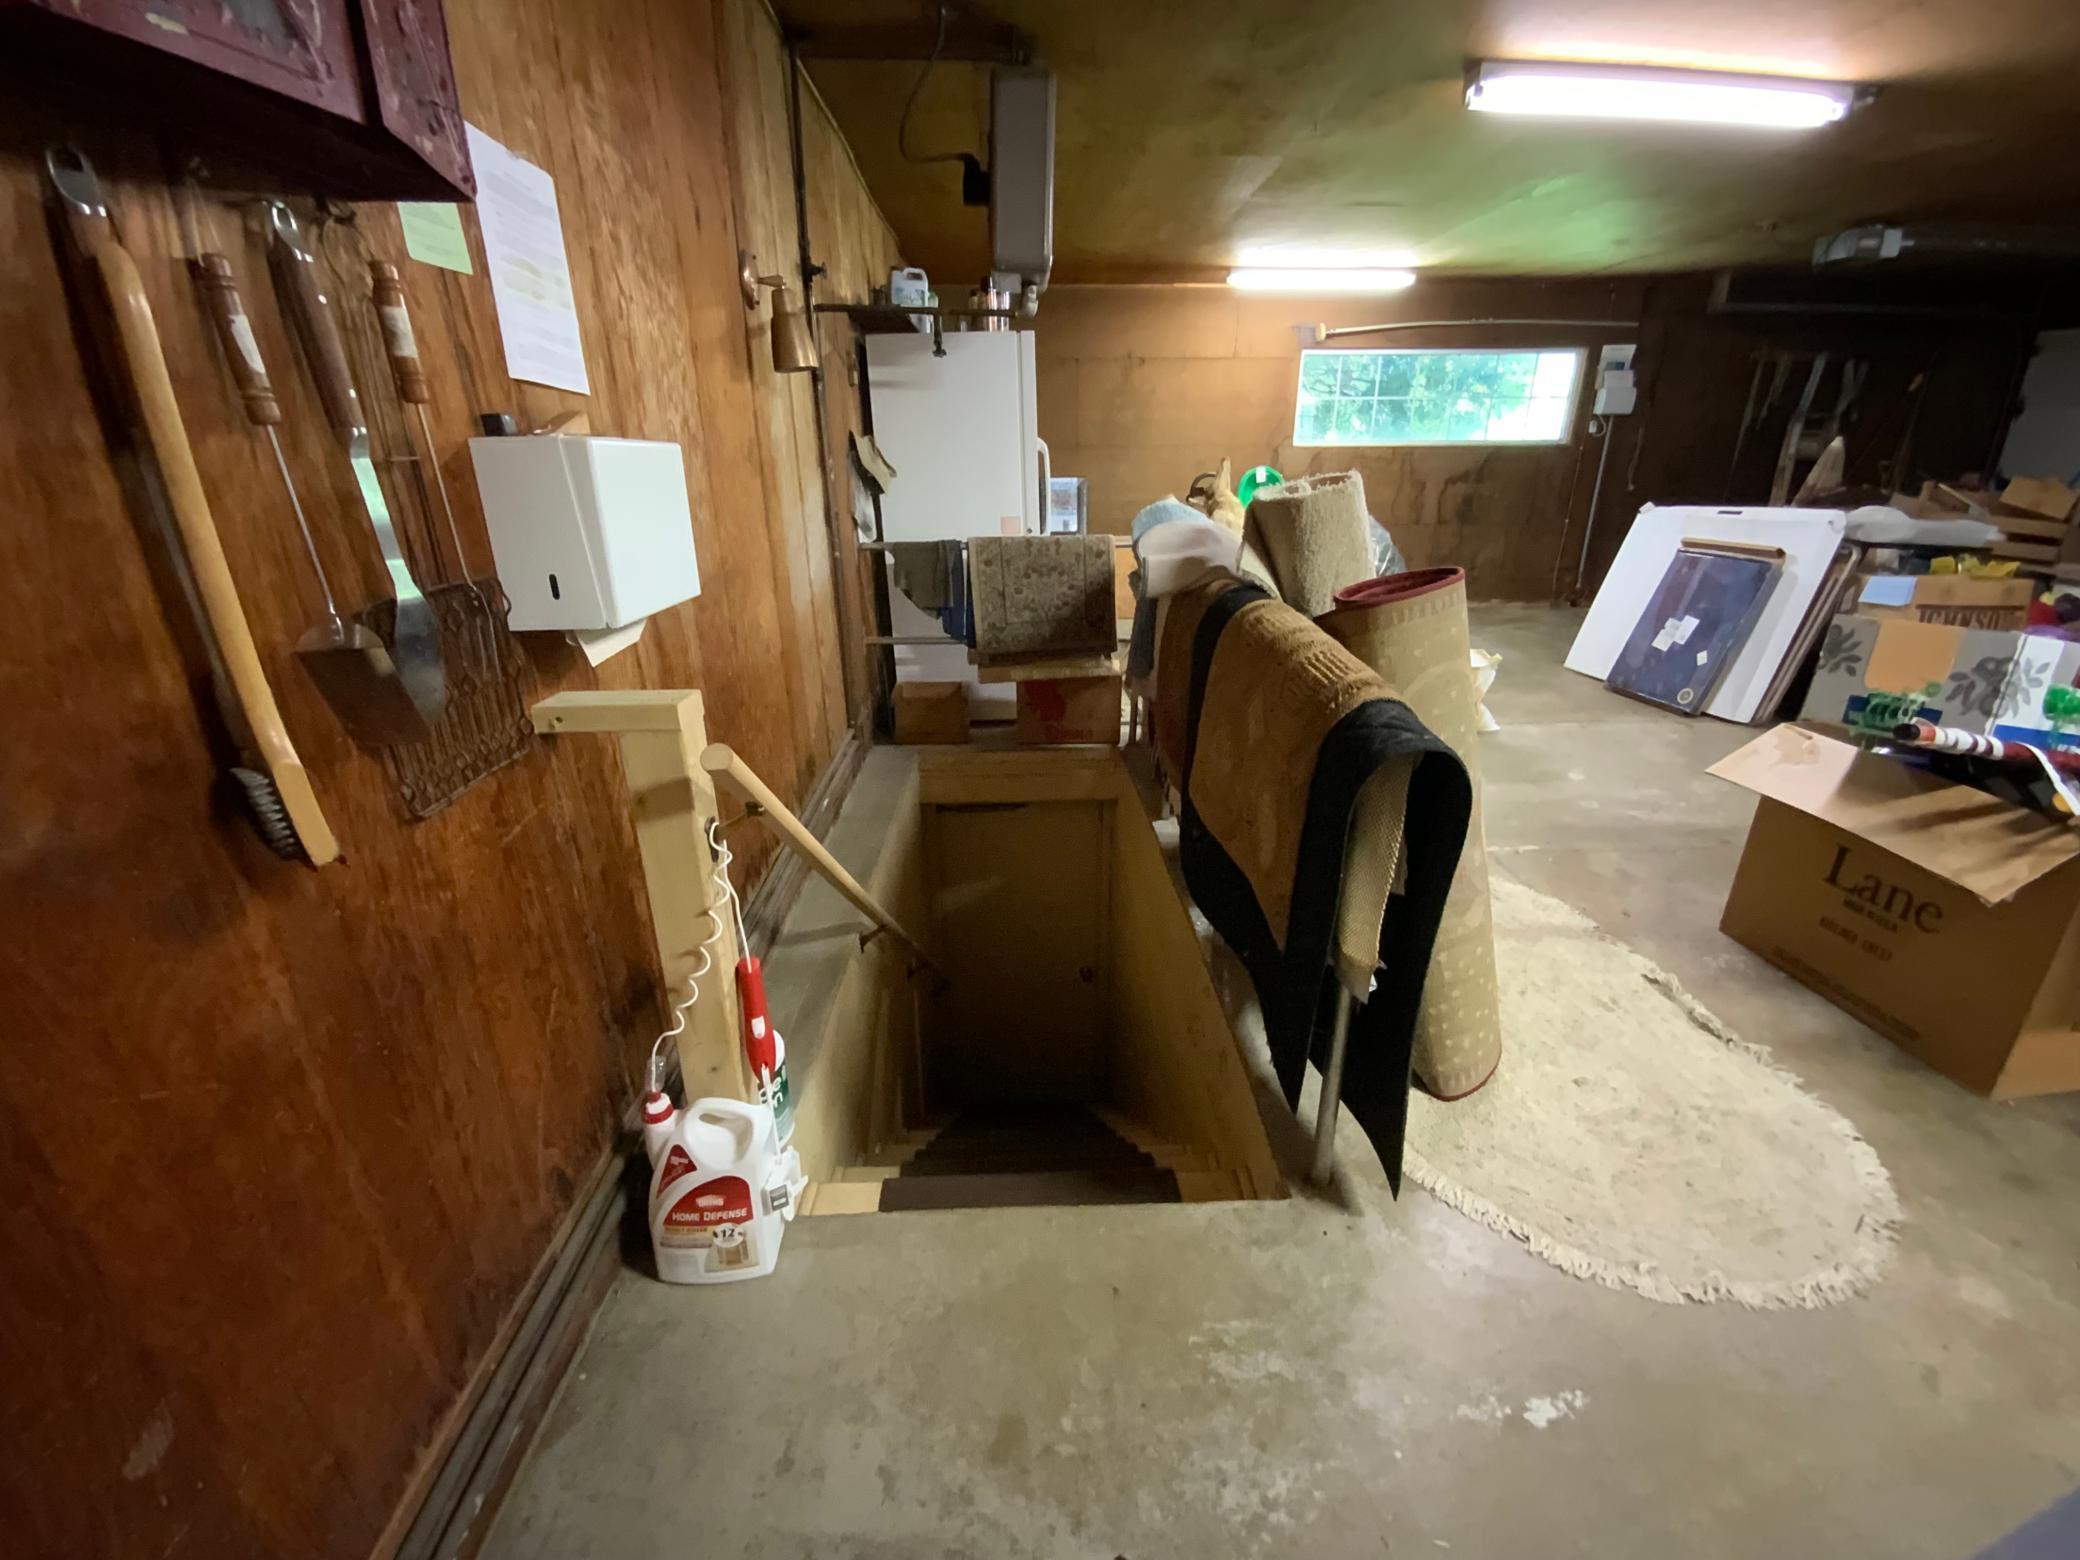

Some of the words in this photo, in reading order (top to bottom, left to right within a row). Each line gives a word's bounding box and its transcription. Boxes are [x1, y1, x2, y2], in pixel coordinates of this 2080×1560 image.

[1822, 843, 1944, 935] Lane
[672, 1212, 701, 1222] HOME
[703, 1208, 748, 1221] DEFENSE
